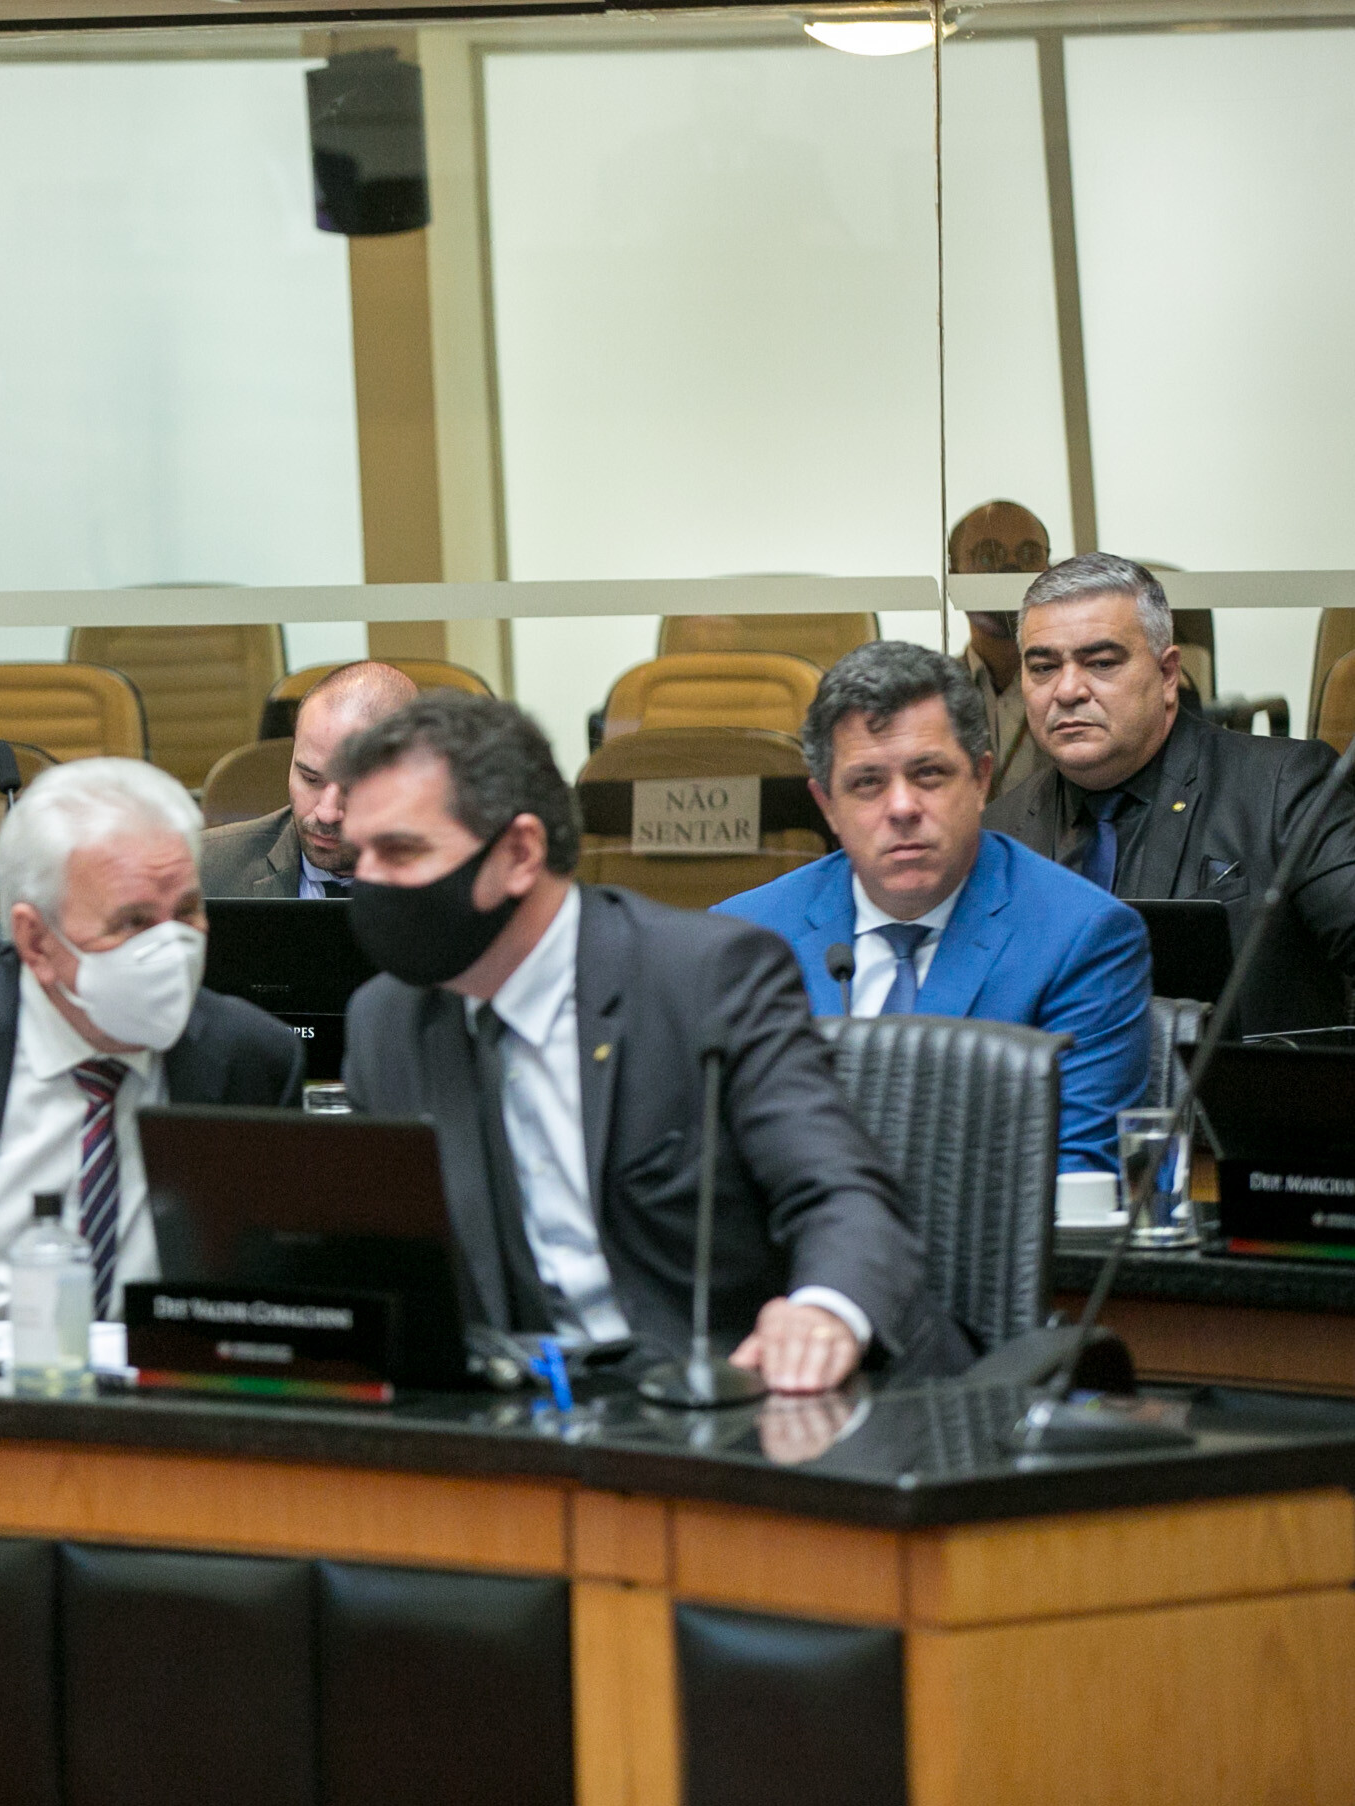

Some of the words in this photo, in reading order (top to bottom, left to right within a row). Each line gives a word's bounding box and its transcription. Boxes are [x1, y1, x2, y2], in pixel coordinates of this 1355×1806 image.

[667, 783, 729, 811] NÃO
[637, 817, 750, 843] SENTAR
[287, 1026, 315, 1038] PES
